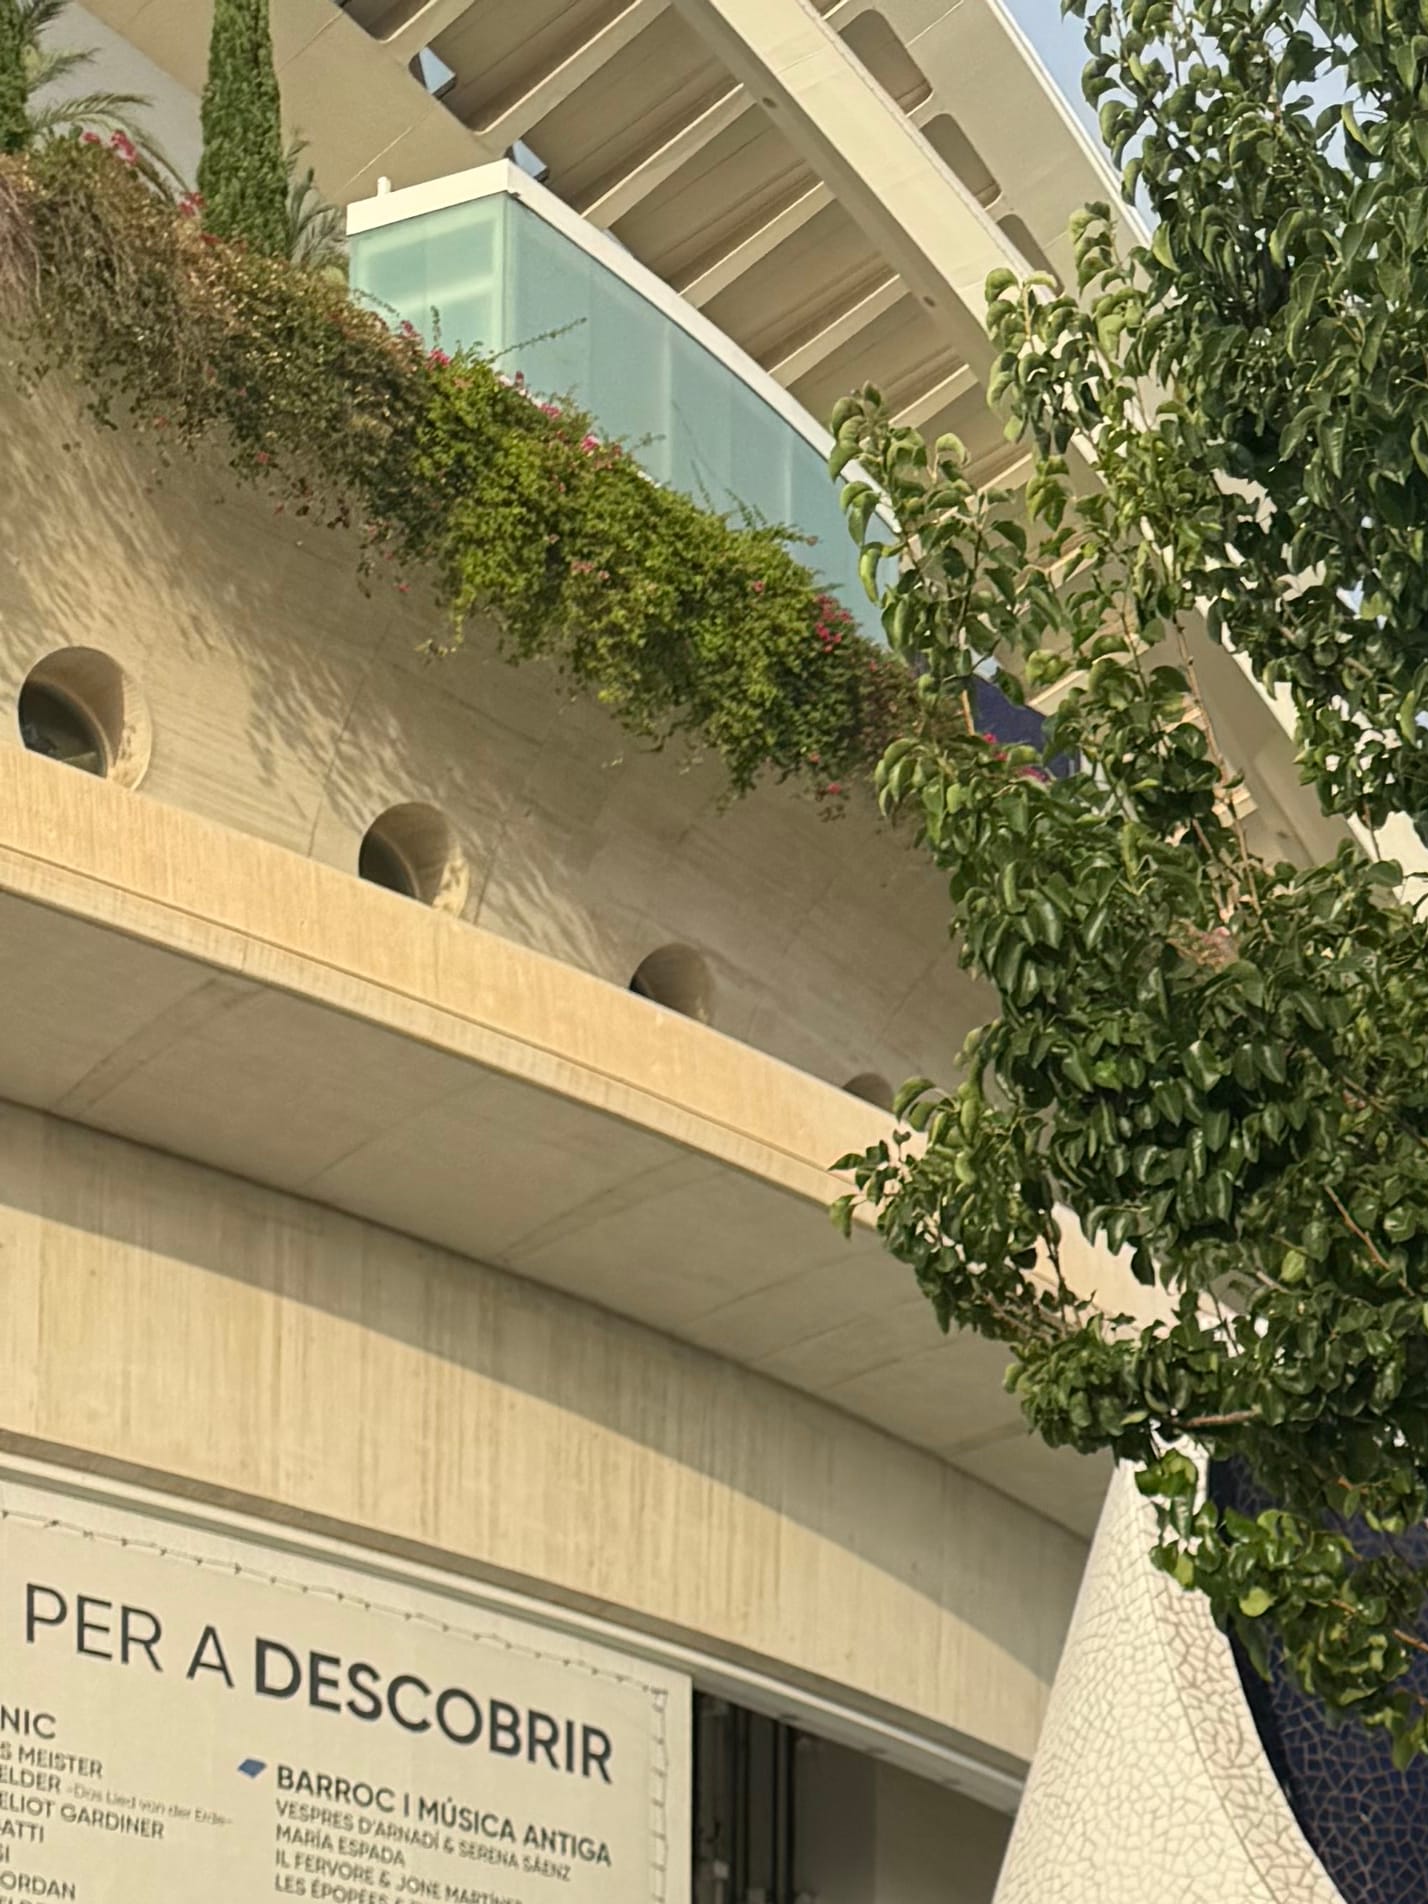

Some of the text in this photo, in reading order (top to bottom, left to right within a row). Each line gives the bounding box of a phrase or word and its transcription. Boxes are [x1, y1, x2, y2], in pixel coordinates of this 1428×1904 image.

[26, 1582, 613, 1784] PER A DESCOBRIR
[18, 1744, 103, 1780] MEISTER
[60, 1803, 164, 1840] GARDINER
[276, 1799, 354, 1832] VESPRES
[277, 1764, 613, 1867] BARROC I MÚSICA ANTIGA
[276, 1824, 405, 1868] MARÍA ESPADA
[275, 1874, 306, 1896] LES
[295, 1853, 374, 1887] FERVORE
[396, 1876, 443, 1900] JONE
